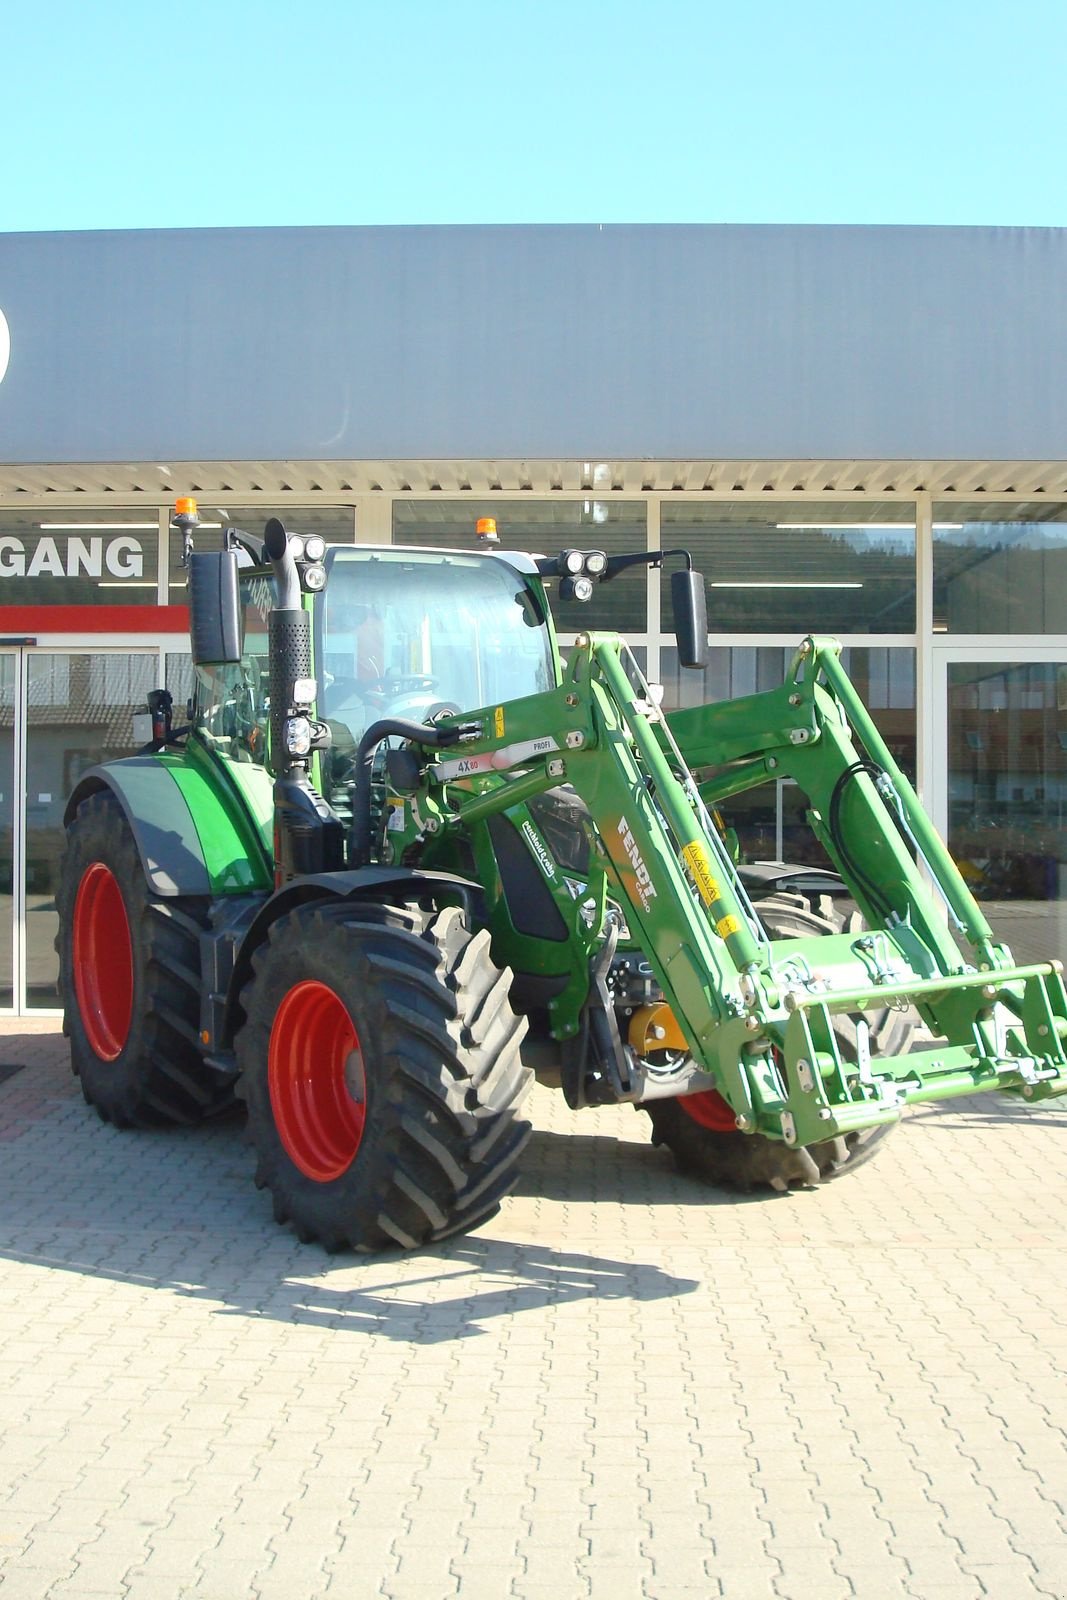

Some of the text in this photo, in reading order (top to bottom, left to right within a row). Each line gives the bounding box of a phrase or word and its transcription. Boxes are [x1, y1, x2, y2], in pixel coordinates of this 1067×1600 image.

[0, 536, 143, 577] GANG
[533, 741, 551, 751] PROFI
[617, 815, 657, 897] FENDT
[635, 881, 651, 913] CARGO
